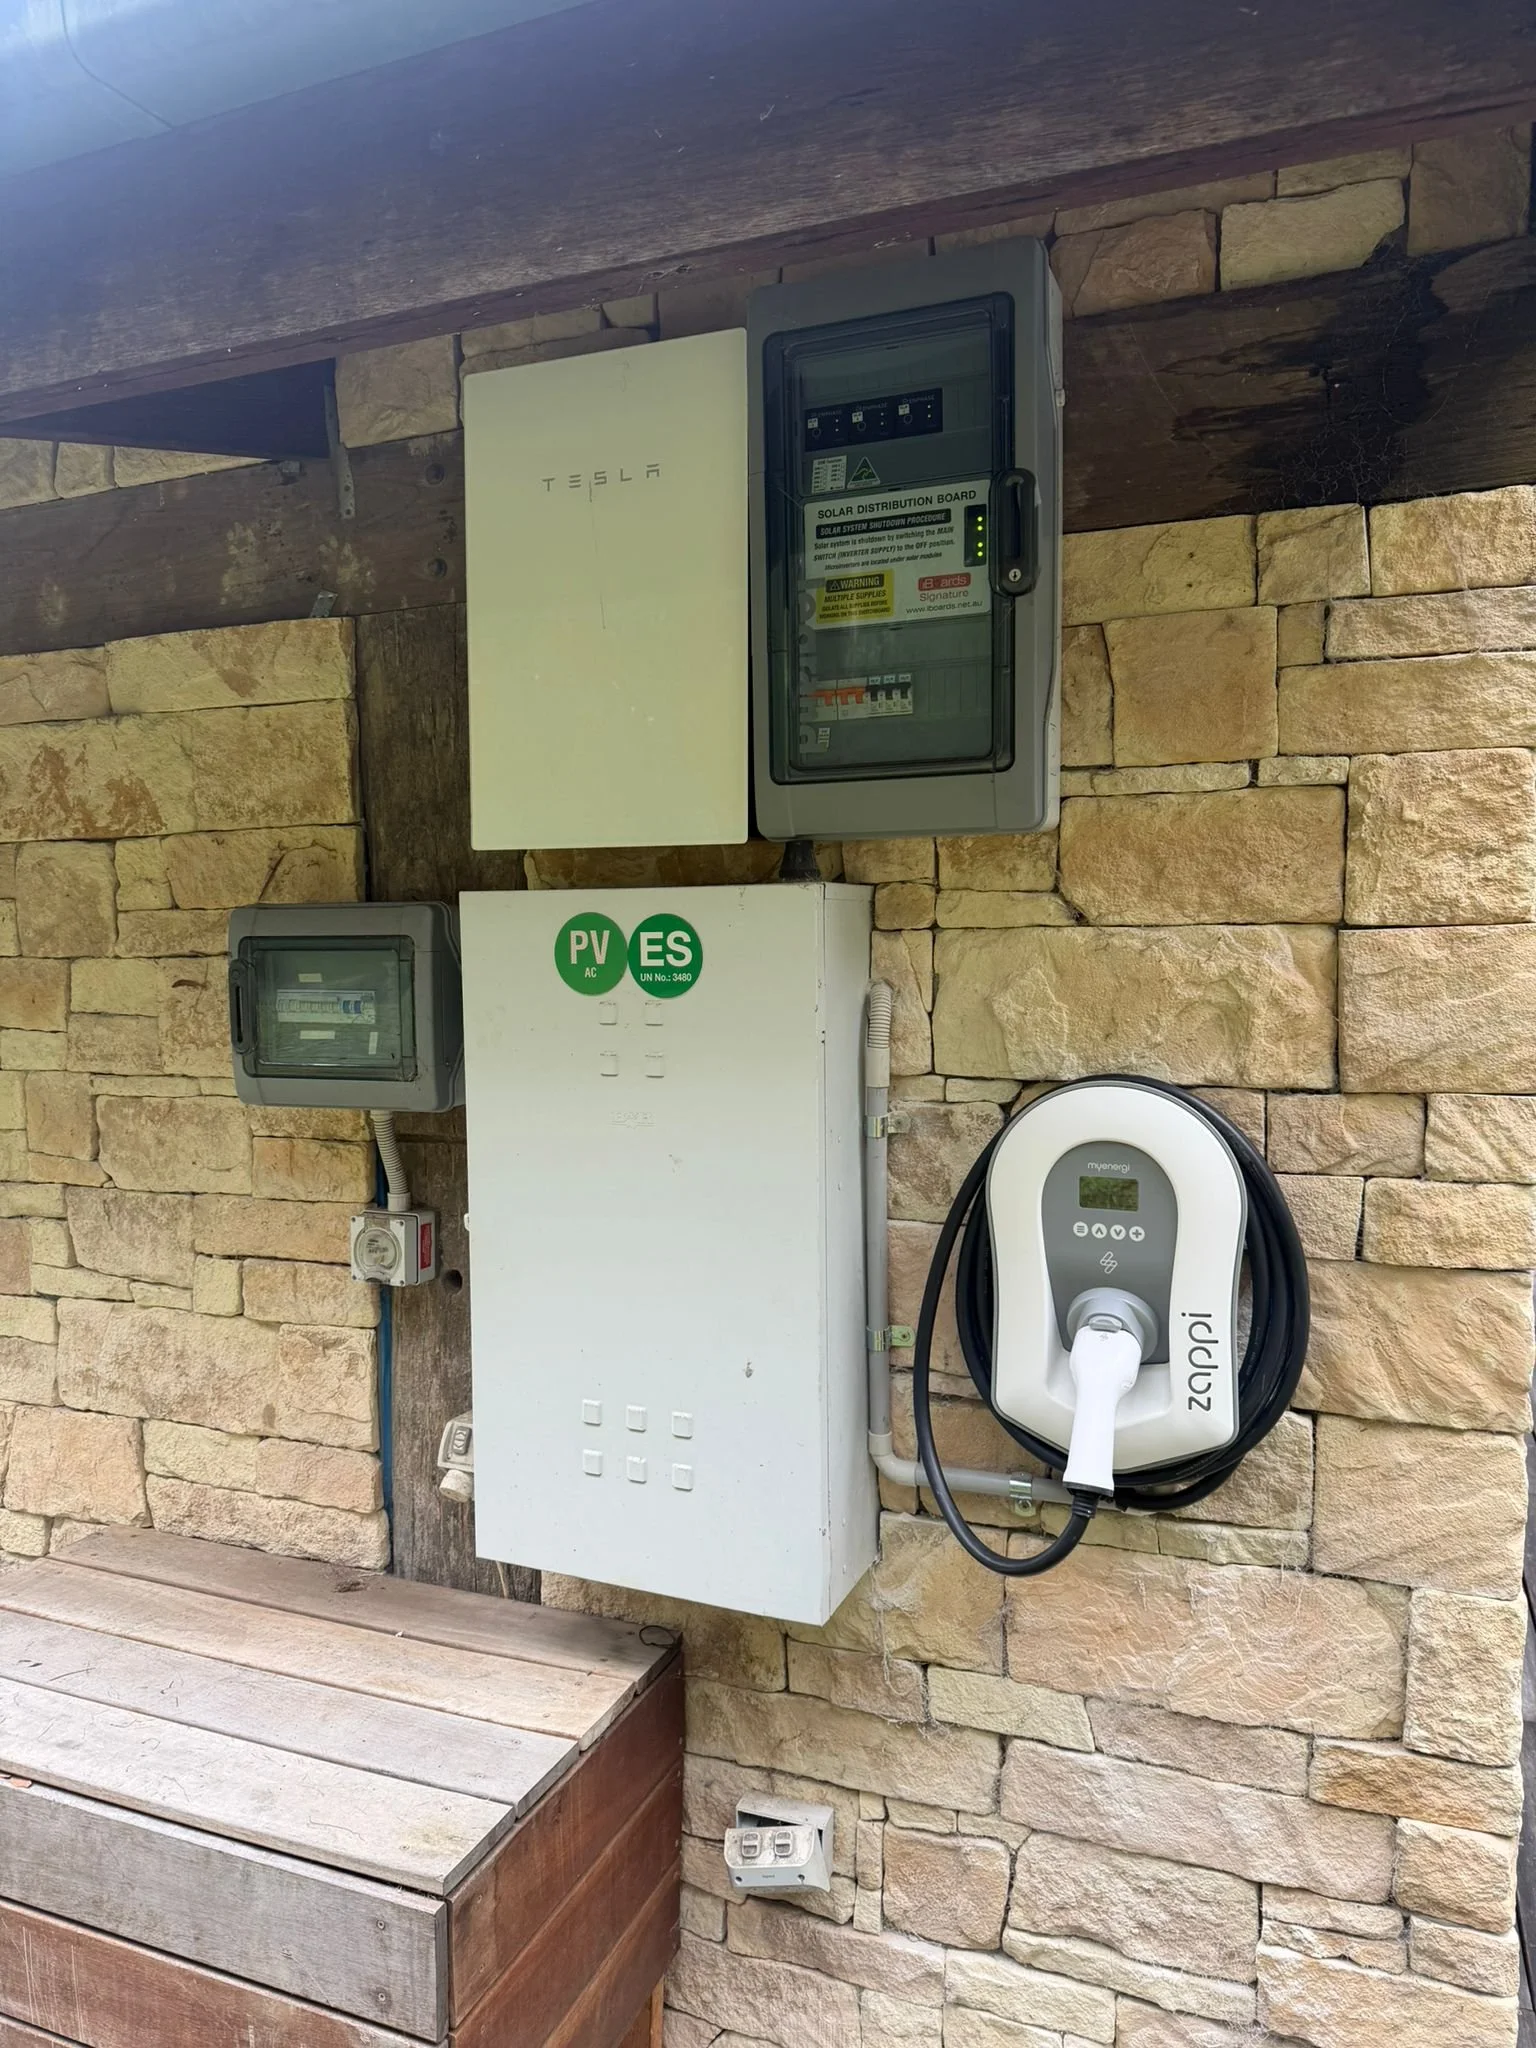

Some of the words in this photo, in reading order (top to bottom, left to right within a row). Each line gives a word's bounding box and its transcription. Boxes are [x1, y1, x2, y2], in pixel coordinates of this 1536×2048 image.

[541, 463, 660, 492] TESLA
[818, 506, 853, 519] SOLAR
[857, 496, 933, 514] DISTRIBUTION
[937, 490, 976, 504] BOARD
[820, 526, 841, 536] SOLAR
[843, 522, 868, 533] SYSTEM
[869, 517, 906, 529] SHUTDOWN
[907, 512, 946, 525] PROCEDURE
[830, 540, 850, 549] system
[858, 535, 886, 544] shutdown
[887, 534, 894, 542] by
[896, 529, 924, 541] switching
[937, 526, 954, 534] MAIN
[813, 552, 836, 561] SWITCH
[838, 548, 870, 560] (INVERTER
[870, 545, 896, 555] SUPPLY)
[904, 543, 914, 551] the
[915, 541, 927, 549] OFF
[840, 576, 880, 589] WARNING
[824, 593, 855, 602] MULTIPLE
[856, 590, 886, 600] SUPPLIES
[920, 590, 969, 602] Signature
[569, 930, 610, 965] PV
[639, 930, 693, 967] ES
[584, 967, 597, 978] AC
[640, 973, 653, 982] UN
[655, 973, 671, 982] No.:
[672, 973, 692, 982] 3480
[1087, 1161, 1130, 1174] myenergi
[1181, 1312, 1219, 1411] zappi
